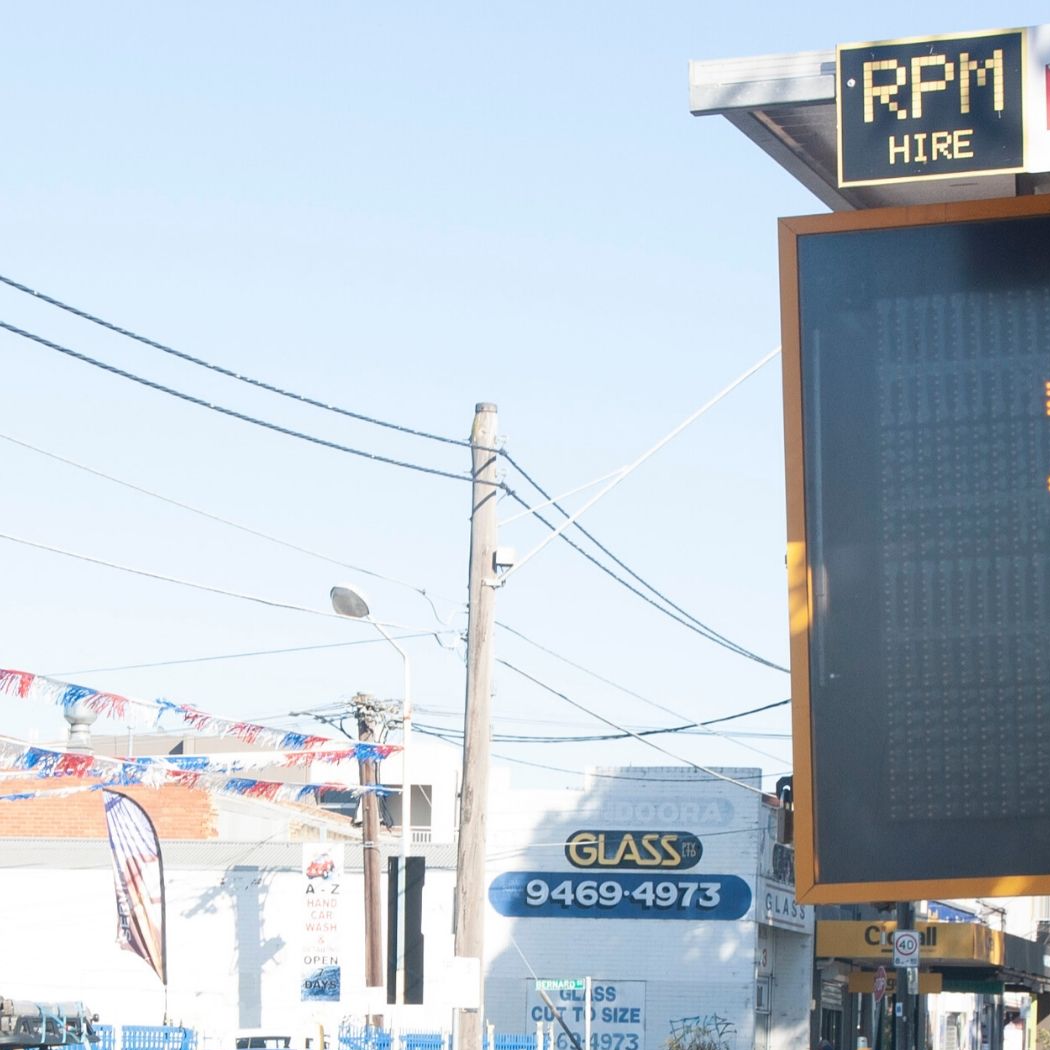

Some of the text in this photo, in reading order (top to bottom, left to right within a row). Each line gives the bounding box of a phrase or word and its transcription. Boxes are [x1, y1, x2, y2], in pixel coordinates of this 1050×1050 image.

[863, 49, 1004, 122] RPM
[889, 129, 974, 164] HIRE
[569, 832, 681, 866] GLASS
[307, 899, 337, 908] HAND
[766, 893, 806, 920] GLASS
[311, 912, 332, 920] CAR
[305, 922, 337, 931] WASH
[899, 940, 914, 949] 40
[304, 956, 338, 965] OPEN
[305, 980, 337, 988] DAYS
[536, 980, 576, 990] BERNARD
[602, 1008, 641, 1023] SIZE
